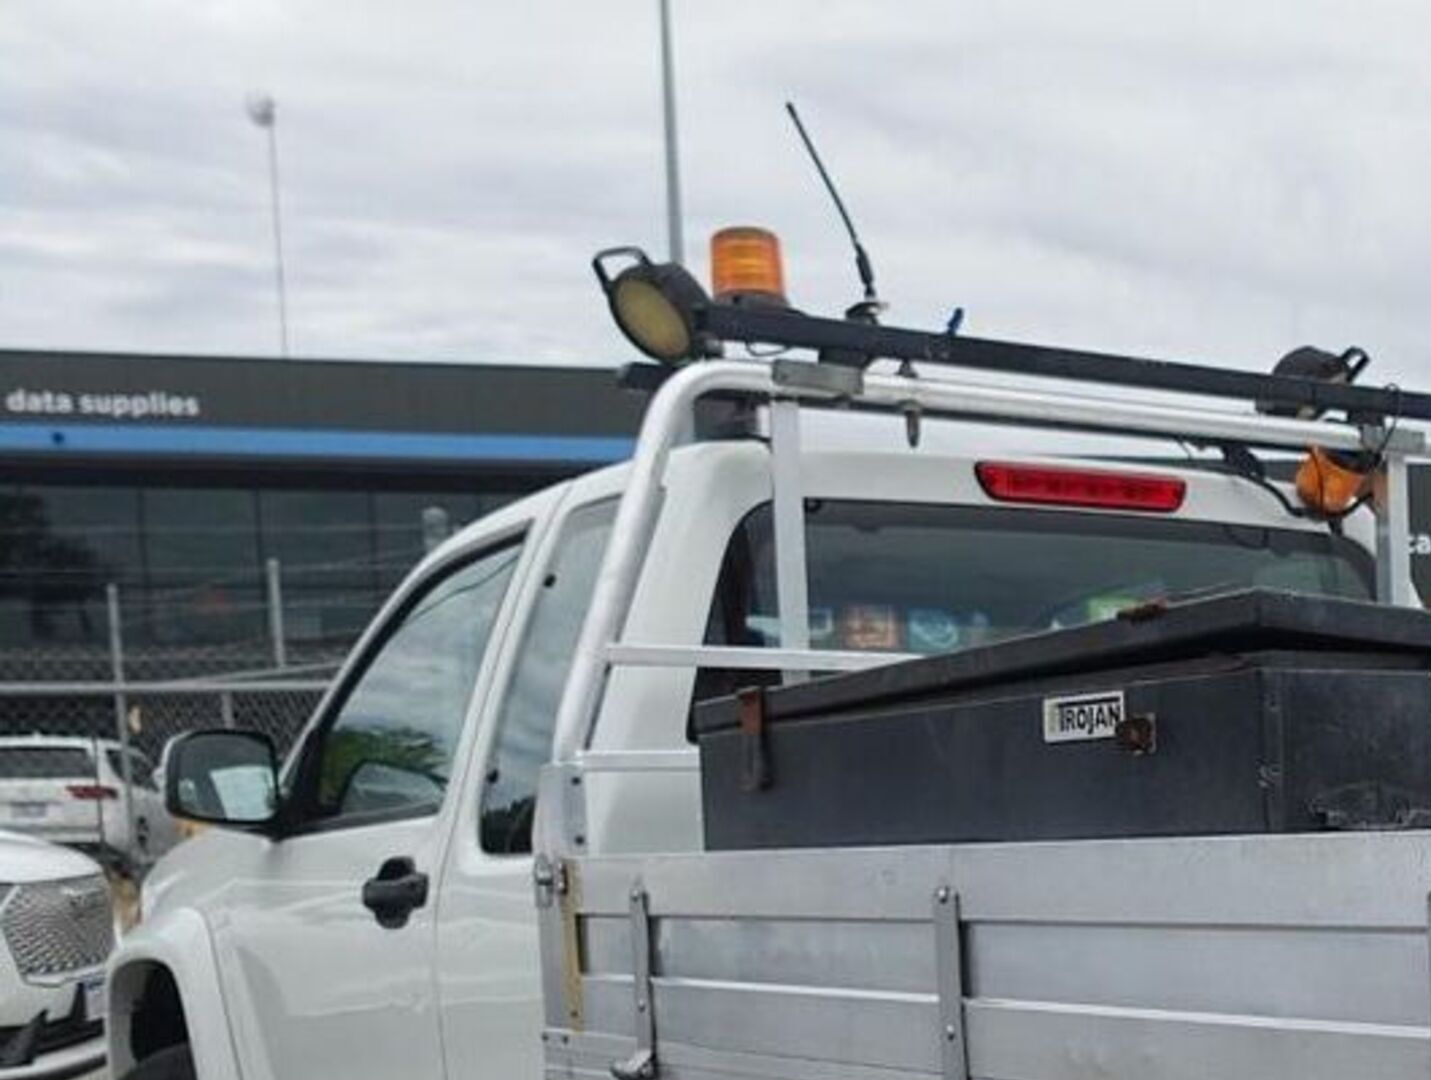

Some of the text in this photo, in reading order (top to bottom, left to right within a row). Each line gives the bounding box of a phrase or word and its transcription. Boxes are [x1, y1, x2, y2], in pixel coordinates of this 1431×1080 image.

[6, 387, 200, 418] data supplies
[1058, 697, 1121, 735] TROJAN
